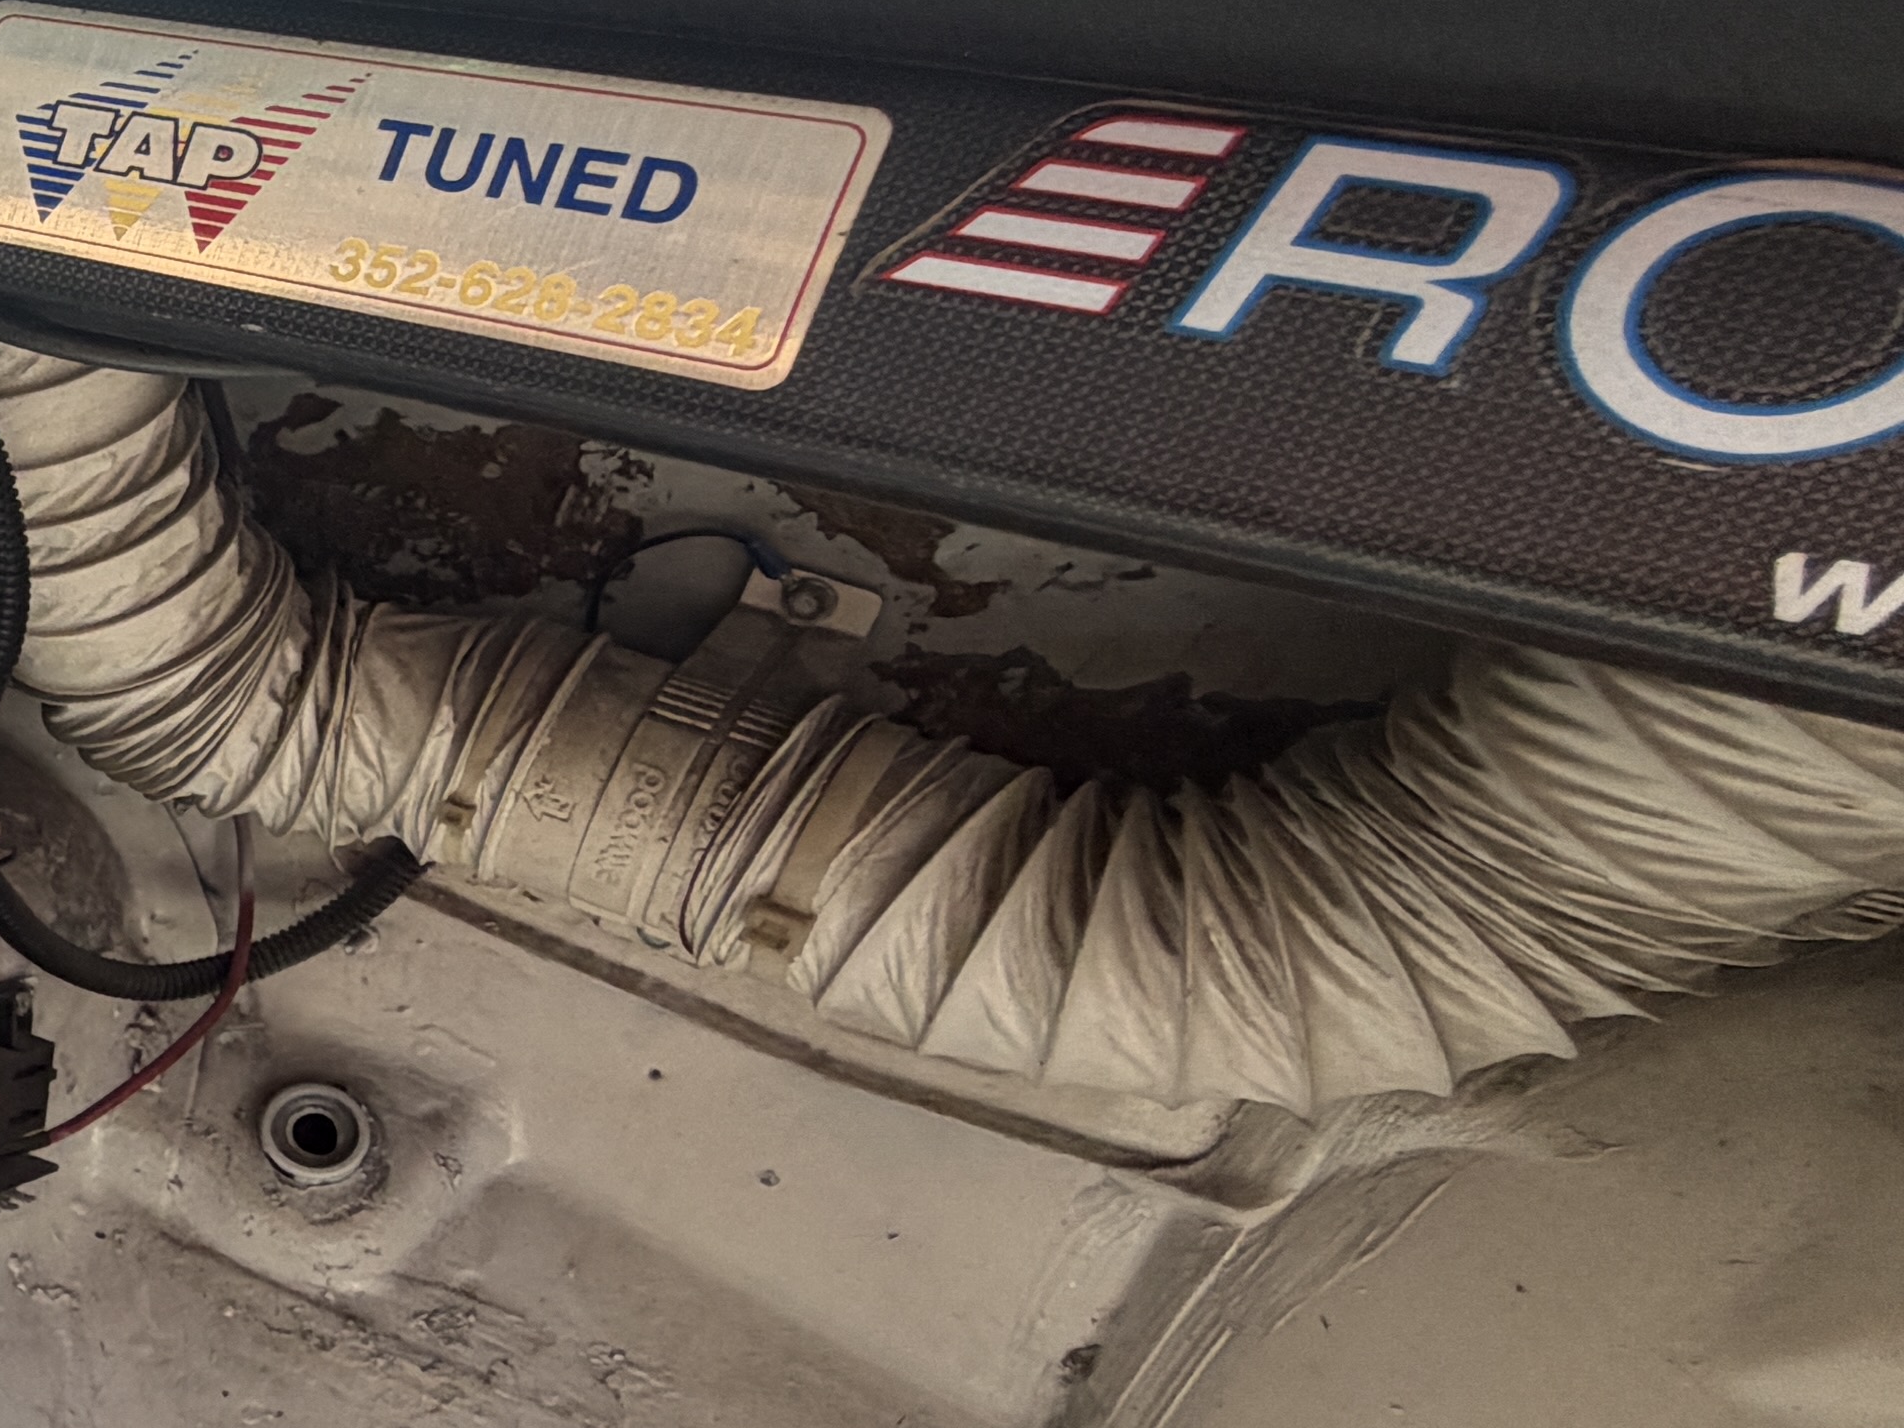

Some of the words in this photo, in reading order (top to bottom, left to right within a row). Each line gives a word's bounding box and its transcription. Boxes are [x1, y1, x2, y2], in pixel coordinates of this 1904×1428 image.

[47, 99, 264, 191] TAP
[377, 118, 700, 224] TUNED
[328, 236, 762, 357] 352-628-2834
